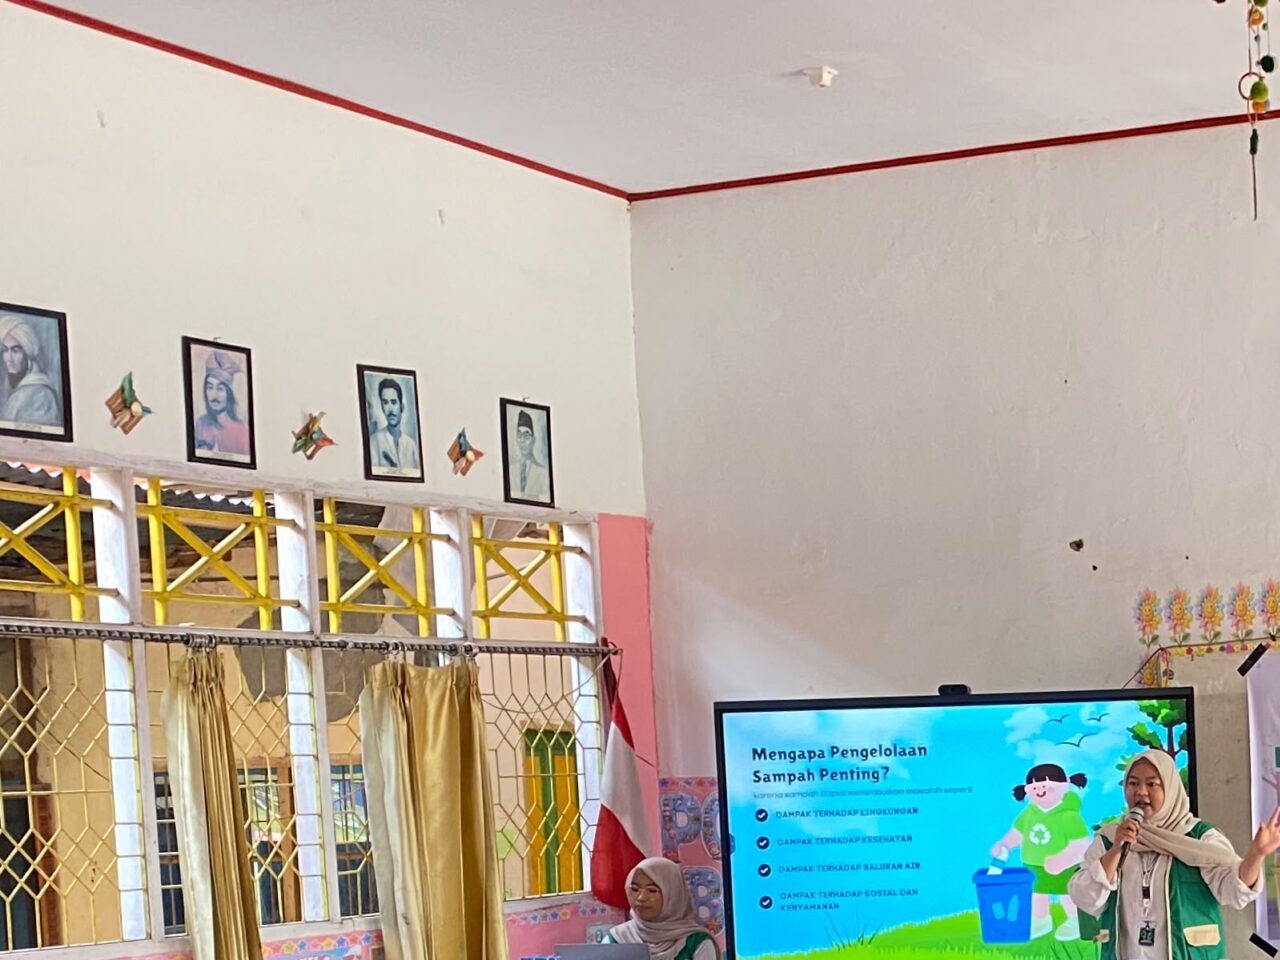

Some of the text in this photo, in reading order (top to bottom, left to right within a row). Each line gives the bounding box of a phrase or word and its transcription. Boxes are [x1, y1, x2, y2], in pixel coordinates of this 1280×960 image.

[752, 744, 928, 763] Mengapa Pengelolaan
[752, 766, 890, 785] Sampah Penting?
[753, 792, 784, 800] karena
[784, 791, 818, 800] sampah
[906, 786, 942, 794] masalah
[944, 786, 973, 794] seperti
[776, 808, 918, 819] DAMPAK TERHADAP LINGKUNGAN
[777, 835, 912, 846] DAMPAK TERHADAP KESEHATAN
[778, 866, 814, 874] DAMPAK
[817, 864, 862, 872] TERHADAP
[864, 862, 902, 871] SALURAN
[780, 888, 918, 900] DAMPAK TERHADAP SOSIAL DAN
[780, 903, 840, 912] KENYAMANAN
